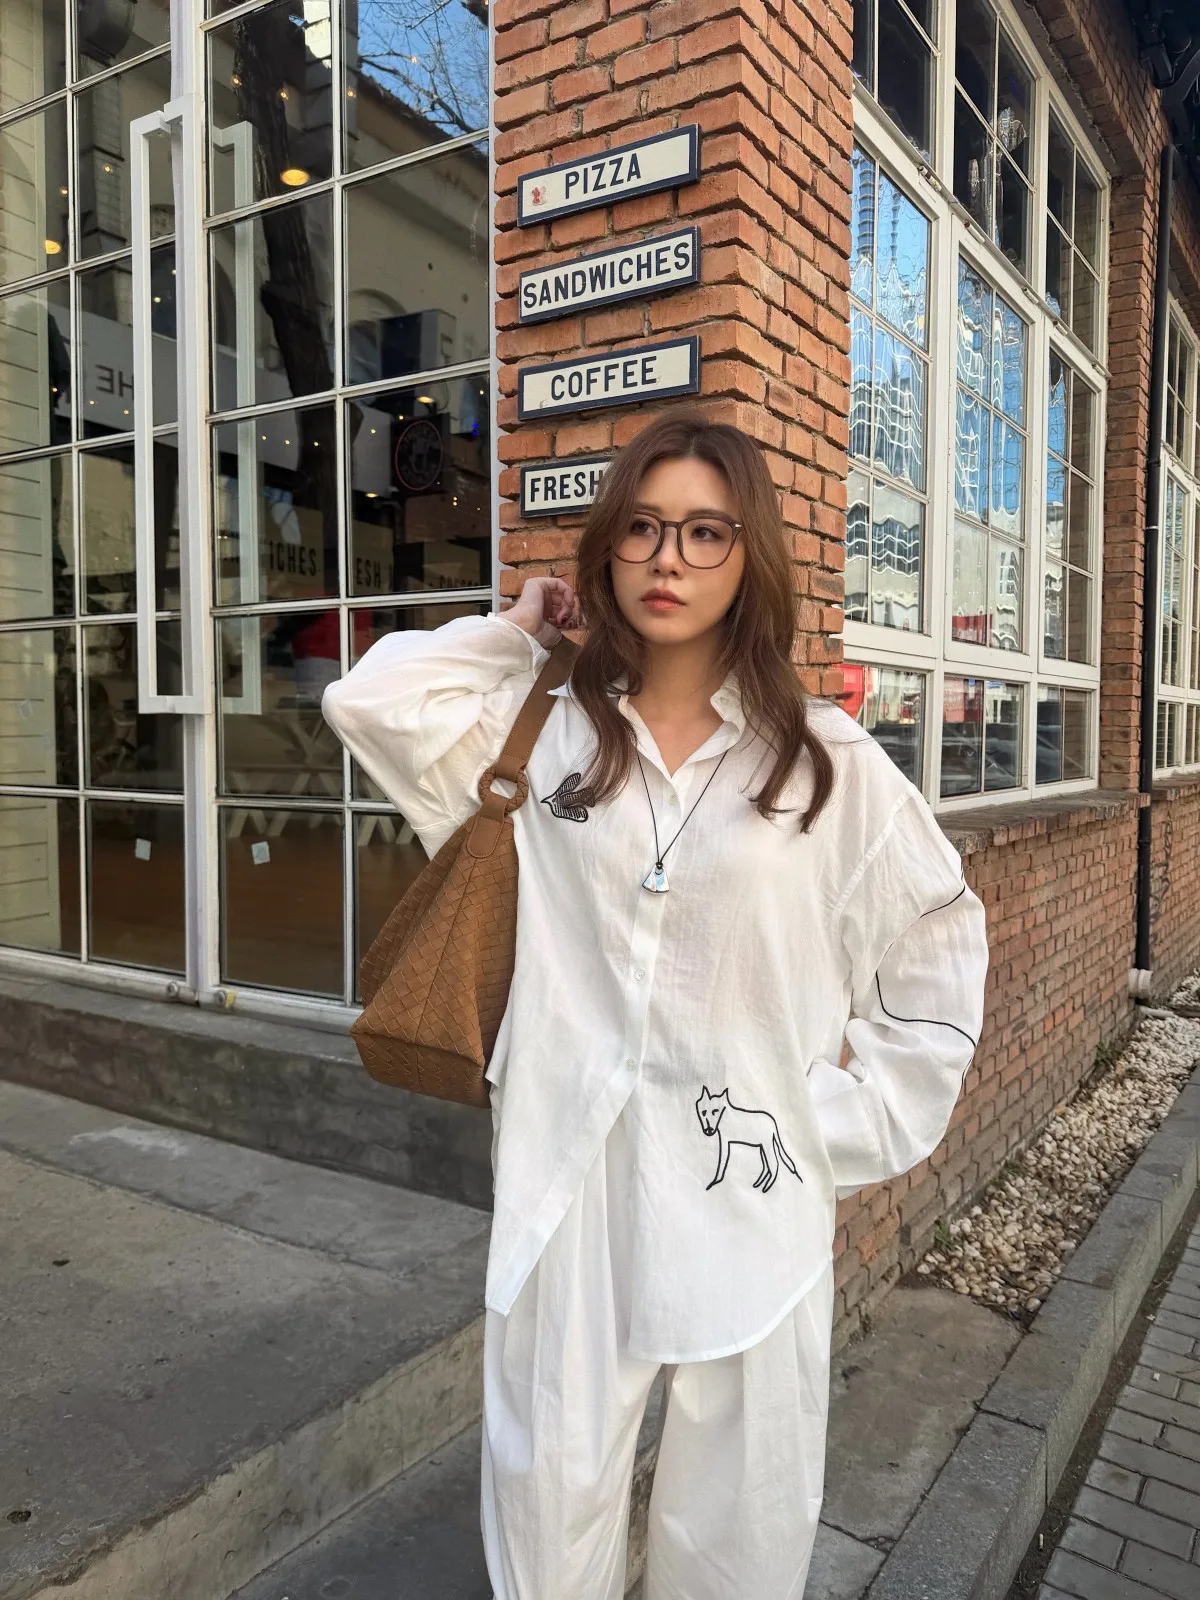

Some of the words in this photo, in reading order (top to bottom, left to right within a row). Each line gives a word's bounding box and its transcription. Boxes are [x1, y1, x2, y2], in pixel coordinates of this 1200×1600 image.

[565, 153, 641, 199] PIZZA
[523, 242, 690, 309] SANDWICHES
[551, 356, 657, 400] COFFEE
